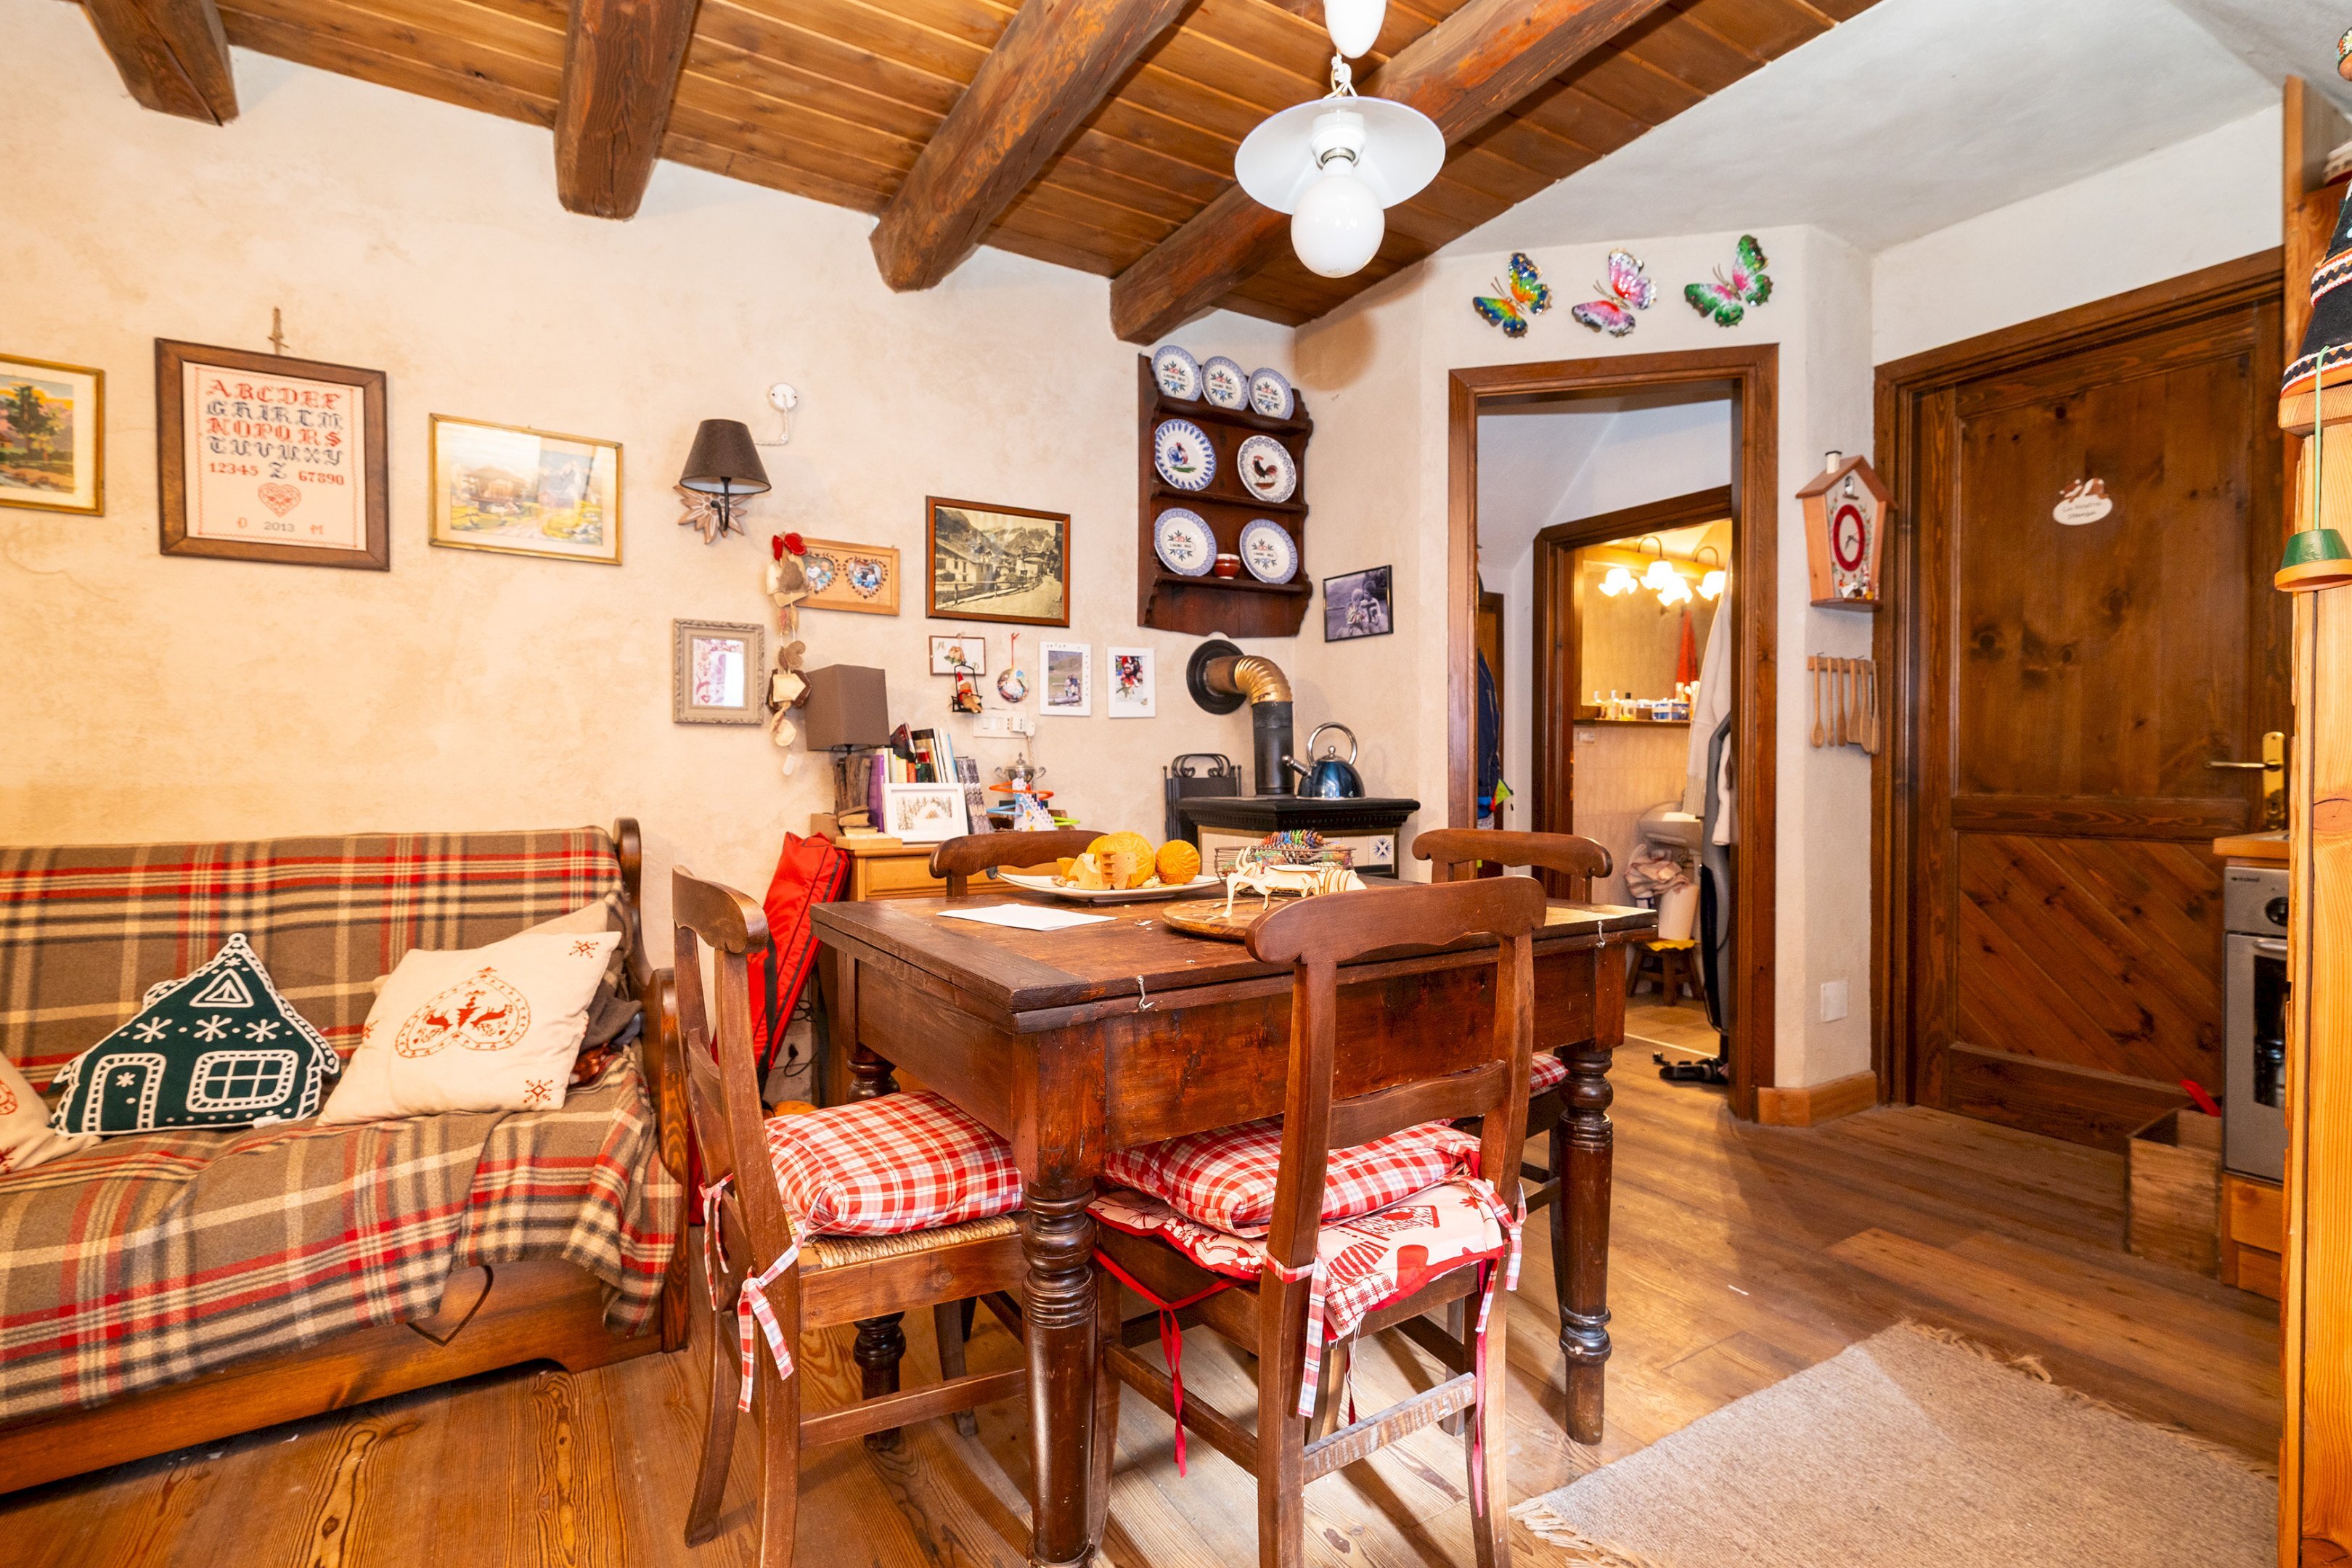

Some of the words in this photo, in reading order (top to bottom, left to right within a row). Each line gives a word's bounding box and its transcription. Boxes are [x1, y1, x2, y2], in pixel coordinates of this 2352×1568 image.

[209, 462, 259, 476] 12345
[298, 470, 345, 485] 67890
[264, 521, 295, 532] 2013
